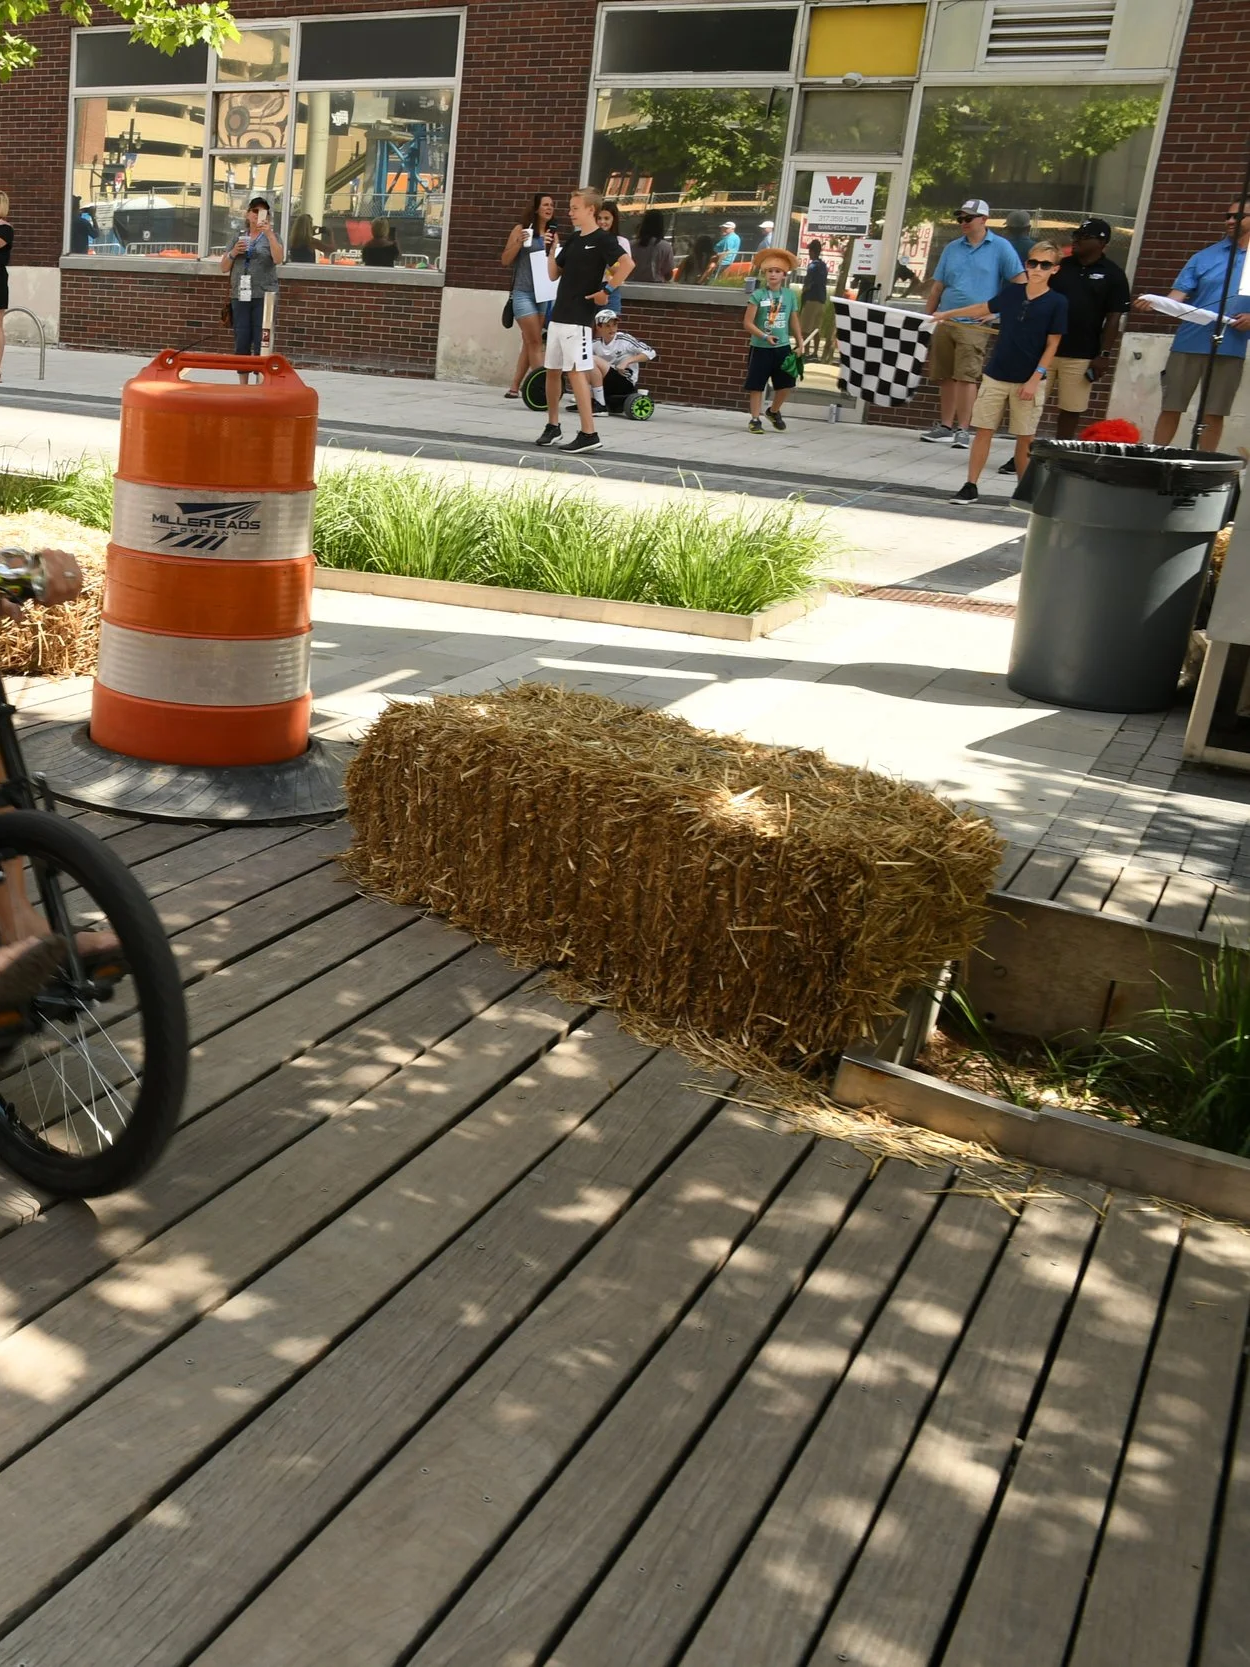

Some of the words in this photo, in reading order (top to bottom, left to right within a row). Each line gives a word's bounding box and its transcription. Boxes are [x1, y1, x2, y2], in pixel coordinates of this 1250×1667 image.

[818, 197, 865, 205] WILHELM
[152, 513, 210, 528] MILLER
[214, 519, 261, 530] EADS
[170, 526, 239, 536] COMPANY
